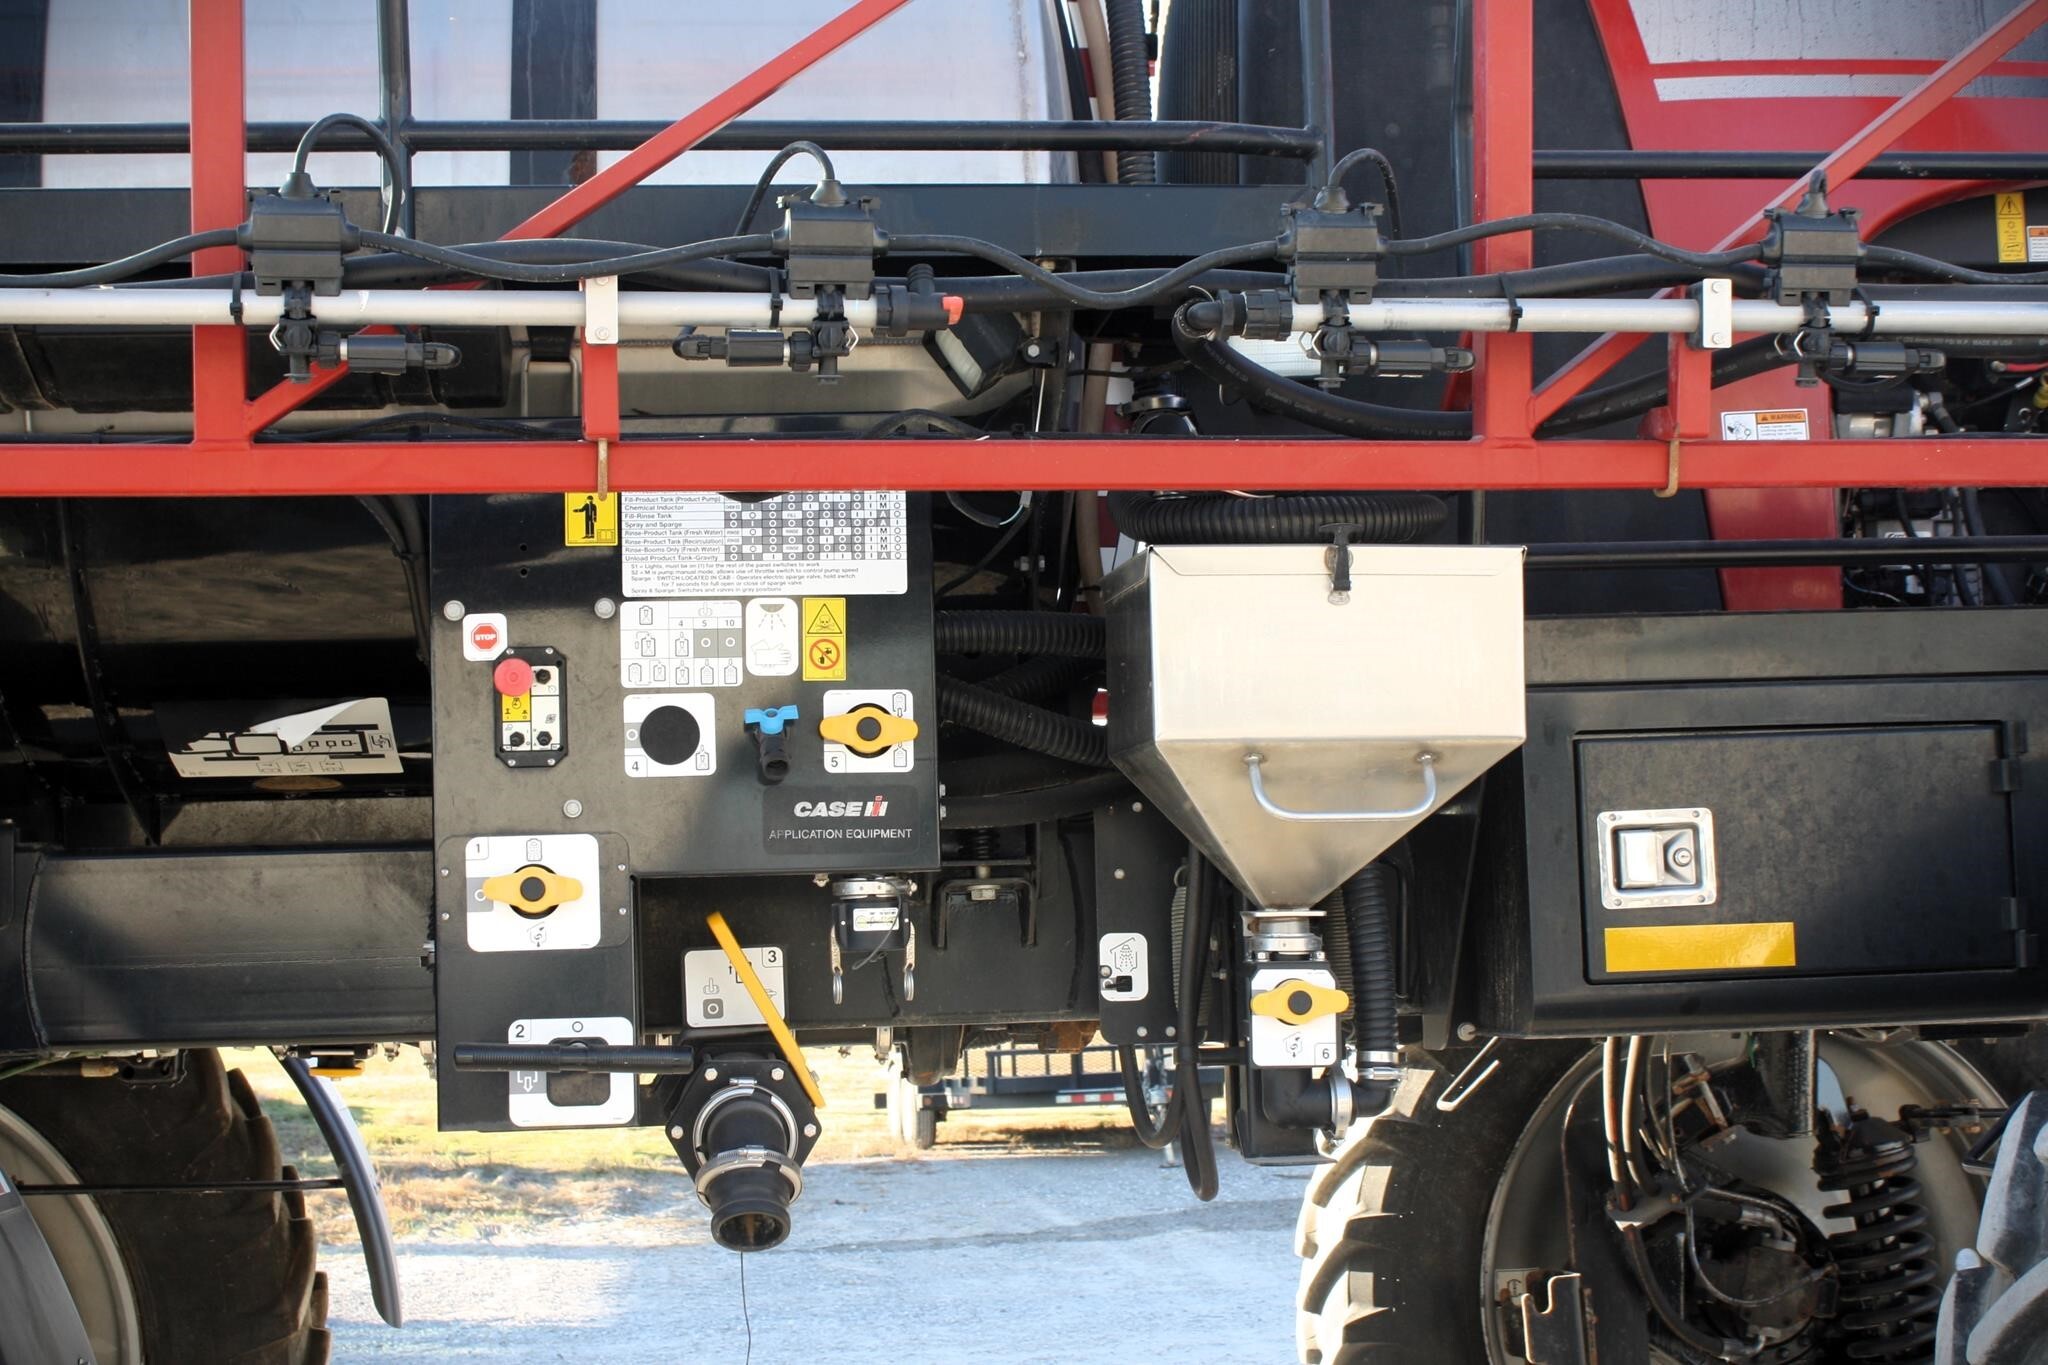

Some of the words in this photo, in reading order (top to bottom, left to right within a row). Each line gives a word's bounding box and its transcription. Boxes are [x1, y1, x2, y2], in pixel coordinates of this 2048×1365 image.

[474, 633, 496, 641] STOP
[631, 760, 640, 772] 4
[831, 756, 839, 768] 5
[793, 801, 865, 817] CASE
[768, 829, 843, 840] APPLICATION
[845, 828, 912, 840] EQUIPMENT
[475, 843, 481, 853] 1
[768, 950, 777, 963] 3
[515, 1024, 524, 1038] 2
[1322, 1048, 1330, 1059] 6
